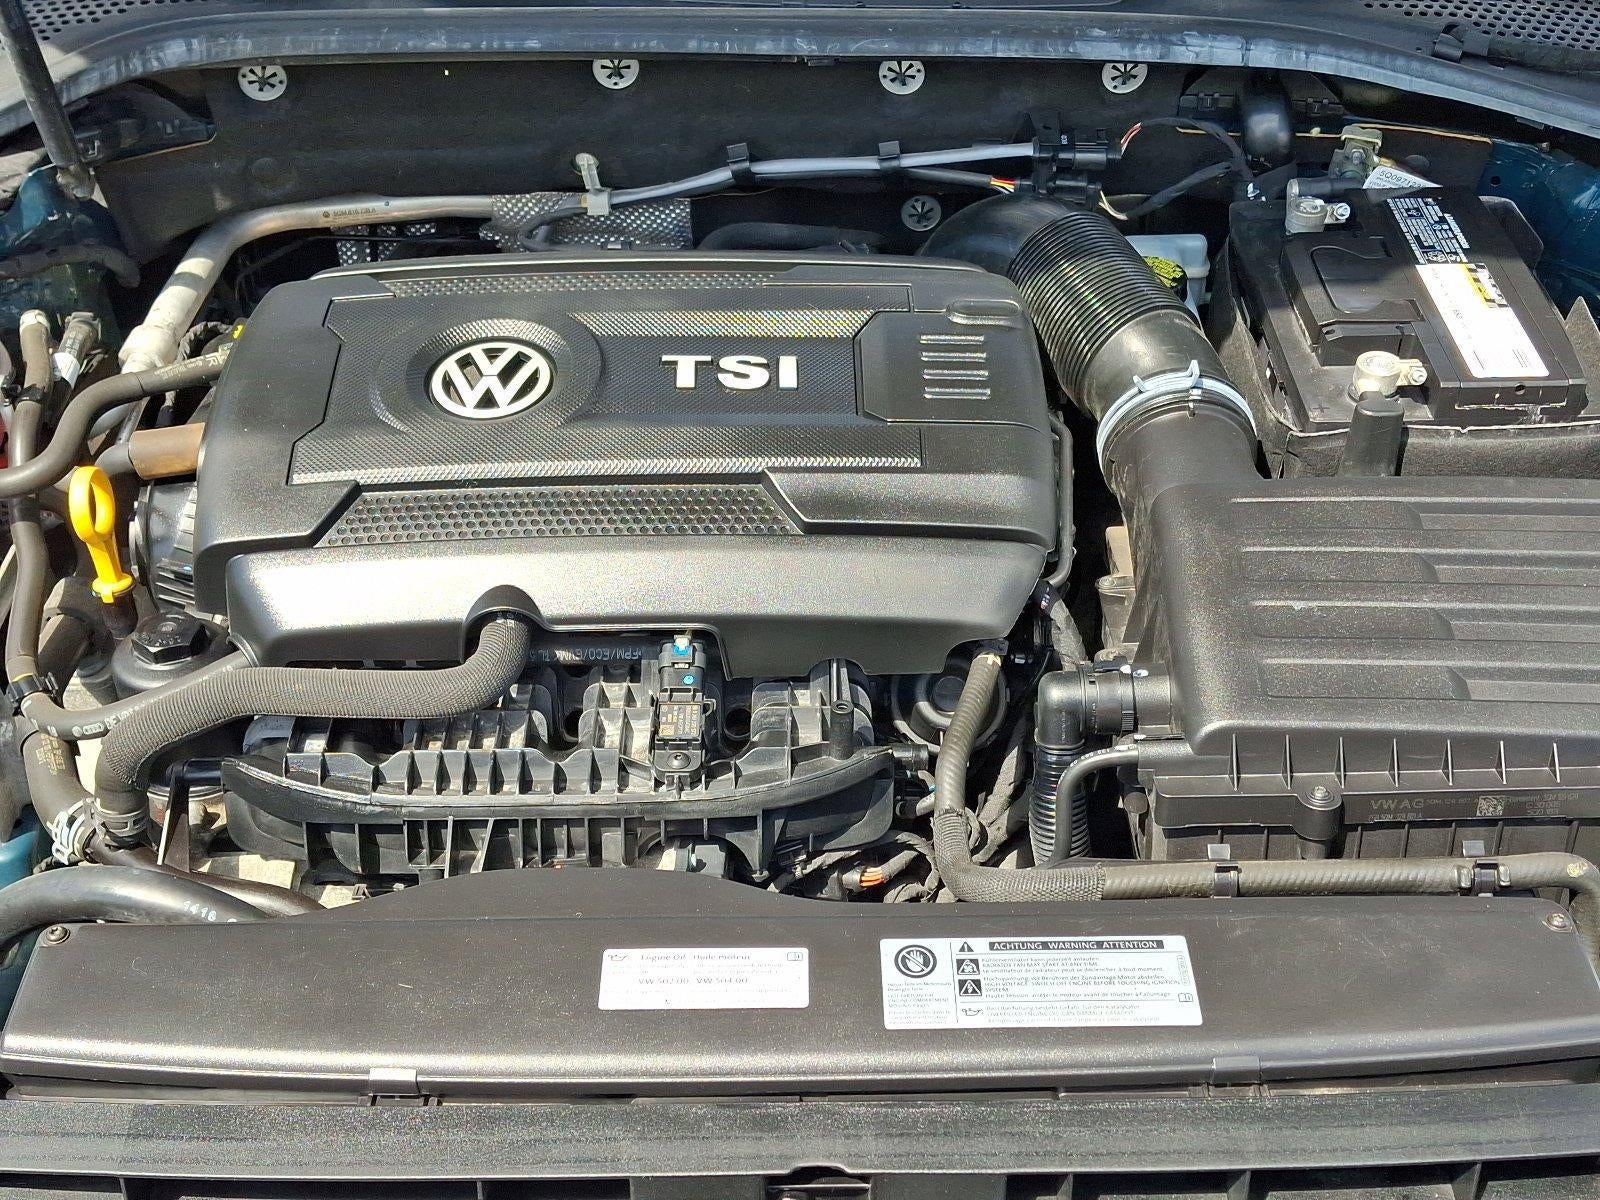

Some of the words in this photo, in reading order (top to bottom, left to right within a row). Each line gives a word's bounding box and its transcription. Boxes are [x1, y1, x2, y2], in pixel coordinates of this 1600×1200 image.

[430, 341, 551, 419] VW
[660, 354, 798, 391] TSI
[1370, 799, 1397, 811] VW
[1400, 799, 1424, 810] AG
[993, 942, 1043, 950] ACHTUNG
[1047, 941, 1097, 949] WARNING
[1102, 940, 1158, 949] ATTENTION
